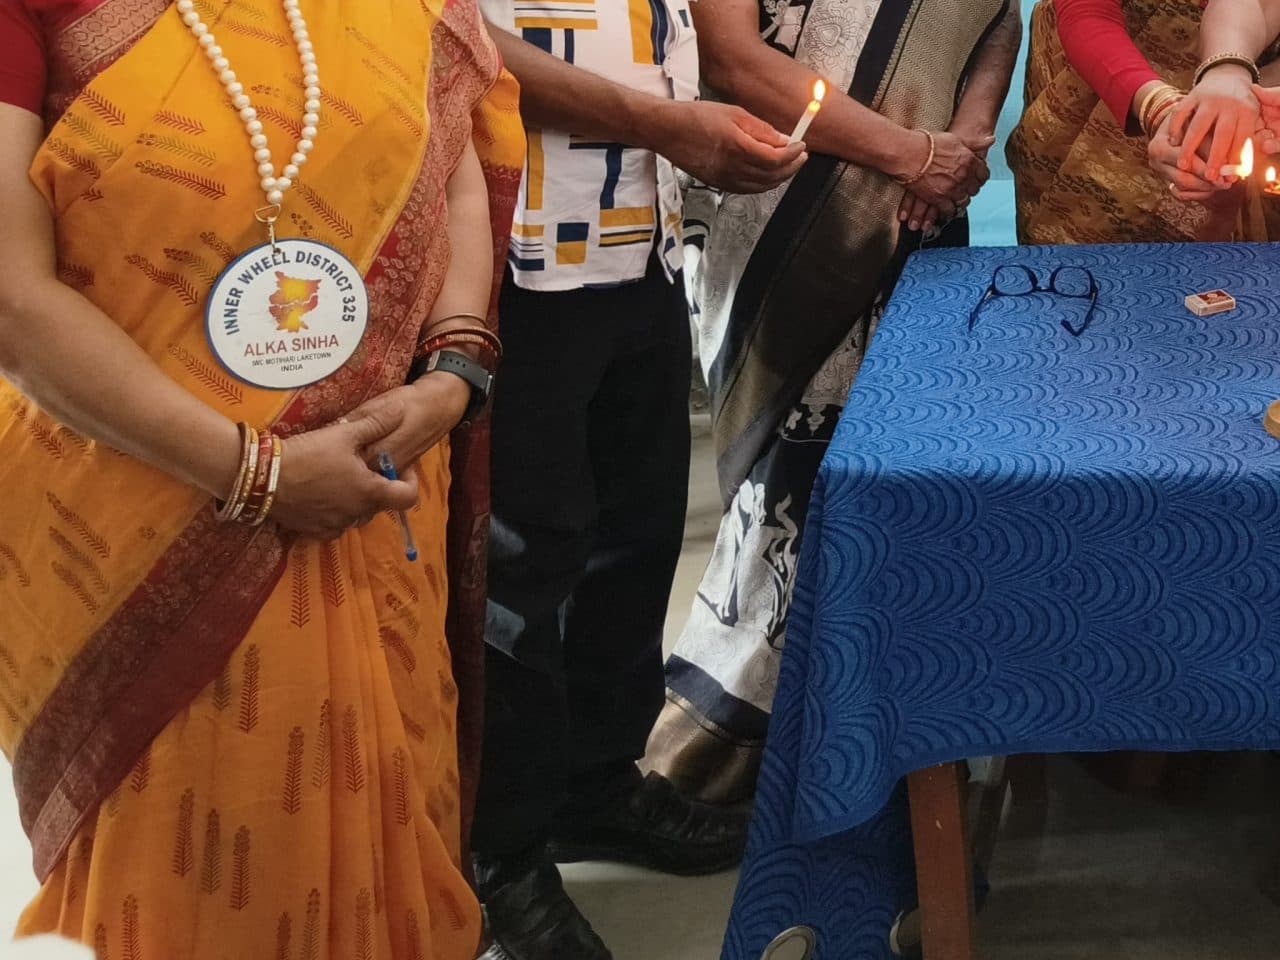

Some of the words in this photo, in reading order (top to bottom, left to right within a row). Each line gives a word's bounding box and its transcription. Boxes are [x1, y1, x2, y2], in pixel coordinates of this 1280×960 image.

[223, 286, 244, 336] INNER
[237, 251, 292, 286] WHEEL
[295, 250, 354, 293] DISTRICT
[342, 295, 356, 324] 325
[244, 340, 288, 358] ALKA
[292, 333, 340, 353] SINHA
[296, 351, 332, 363] LAKETOWN
[281, 363, 304, 372] INDIA
